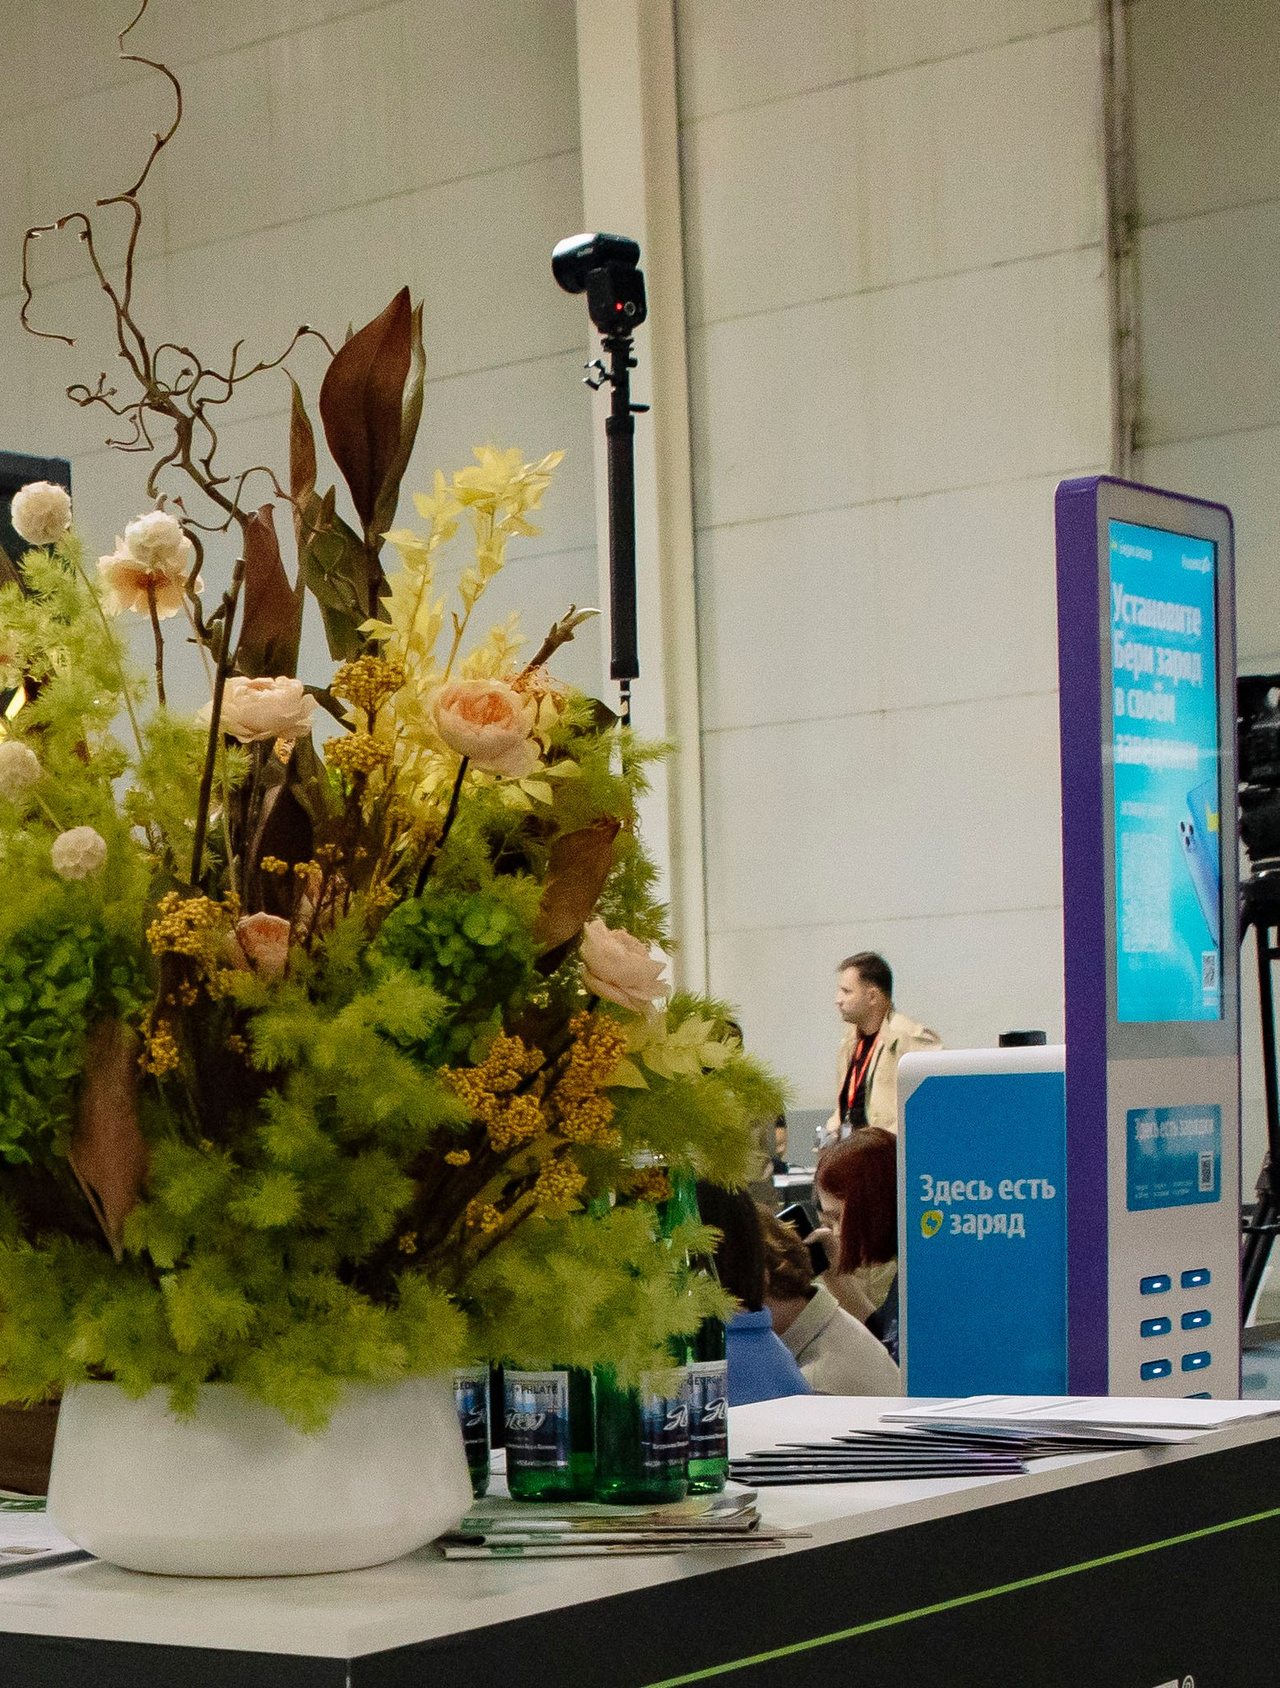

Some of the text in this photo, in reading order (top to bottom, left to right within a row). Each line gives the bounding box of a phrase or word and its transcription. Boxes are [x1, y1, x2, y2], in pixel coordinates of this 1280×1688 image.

[920, 1174, 1056, 1206] Здесь есть
[950, 1213, 1025, 1240] заряд
